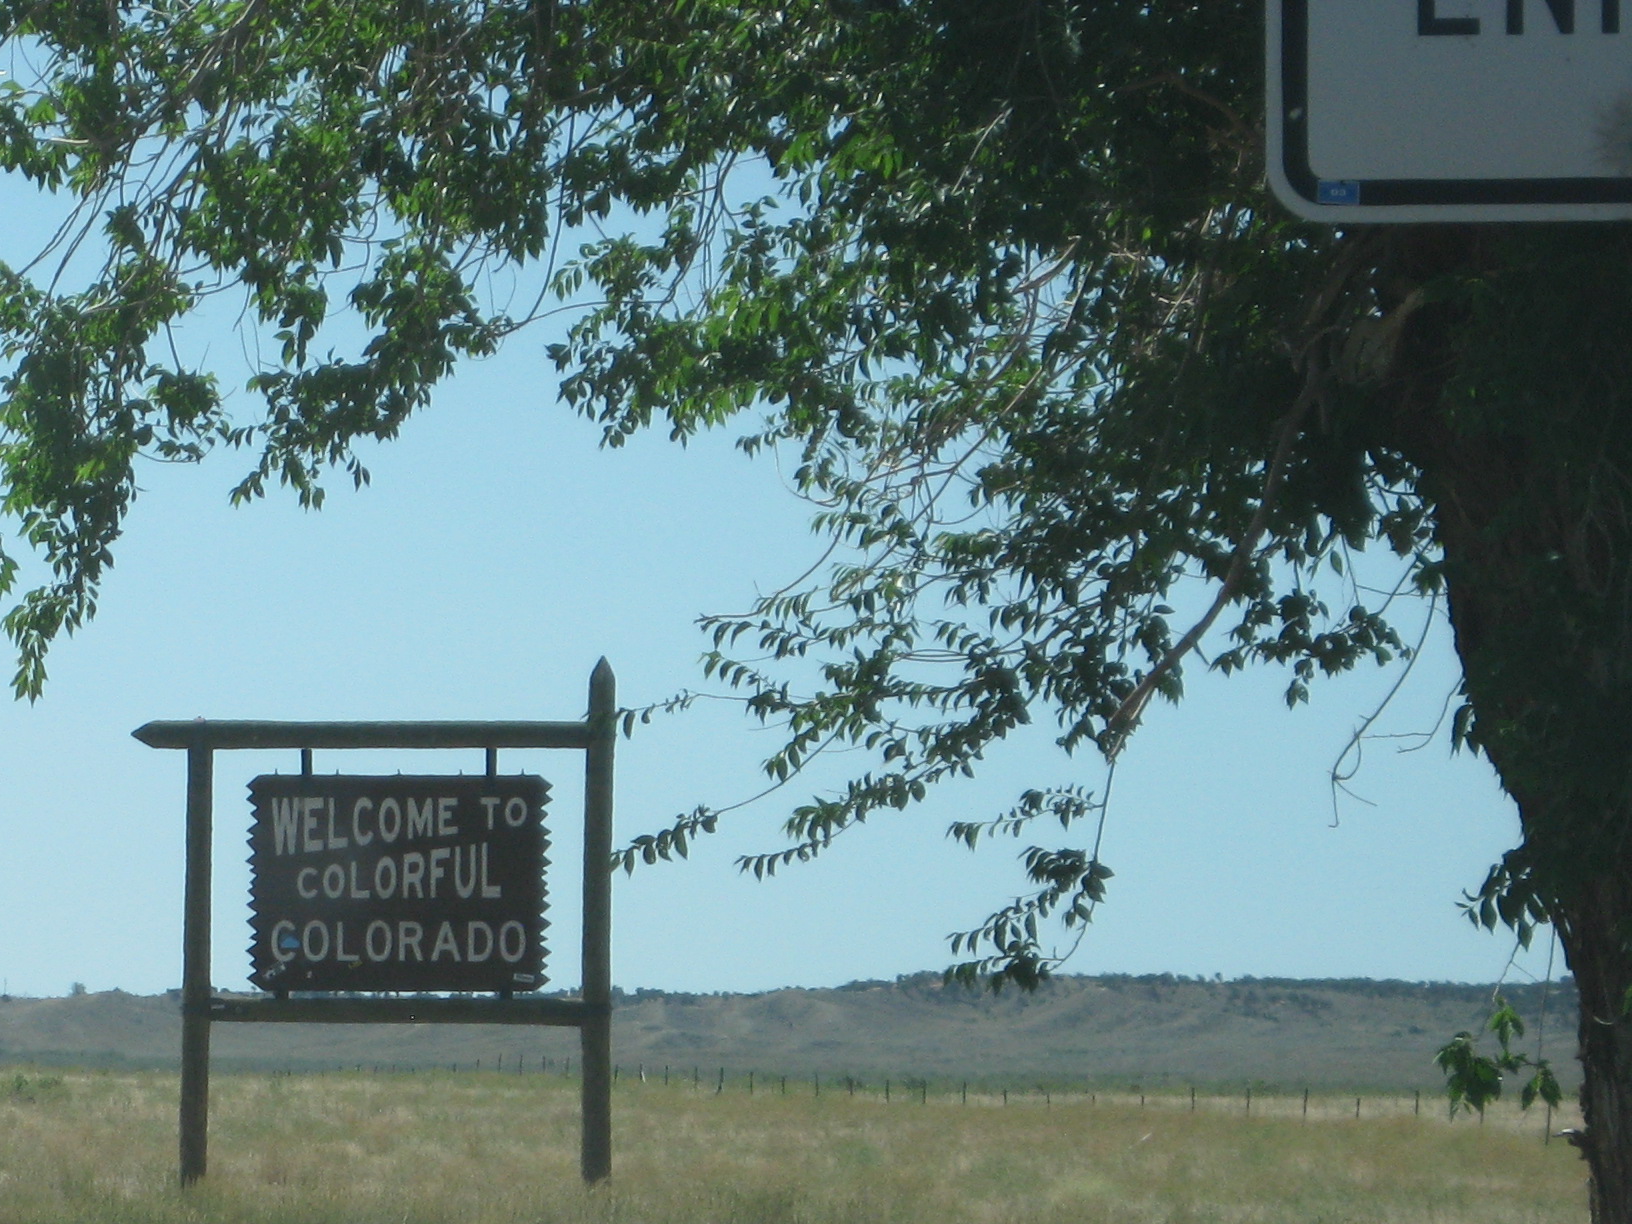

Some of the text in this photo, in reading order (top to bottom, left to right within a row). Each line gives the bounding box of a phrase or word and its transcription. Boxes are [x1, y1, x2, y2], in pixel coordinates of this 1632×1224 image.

[271, 797, 528, 856] WELCOME TO
[296, 842, 502, 899] COLORFUL
[271, 920, 527, 963] COLORADO
